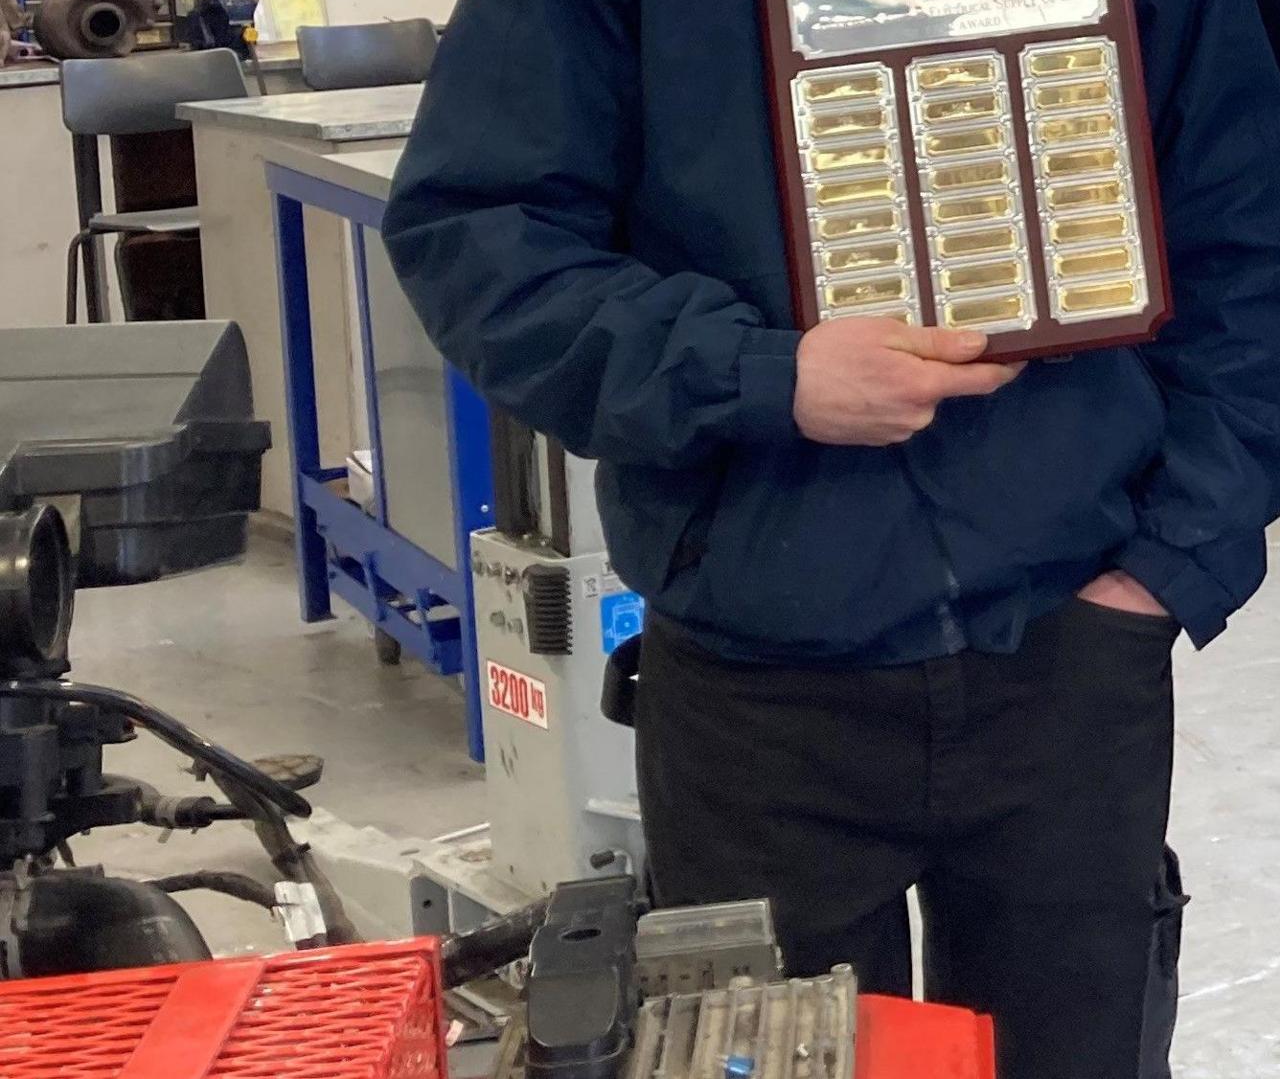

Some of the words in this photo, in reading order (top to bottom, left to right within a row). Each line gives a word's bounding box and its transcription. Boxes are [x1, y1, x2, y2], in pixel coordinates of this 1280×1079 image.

[958, 15, 1002, 31] AWARD
[489, 665, 530, 719] 3200
[529, 682, 546, 720] kg
